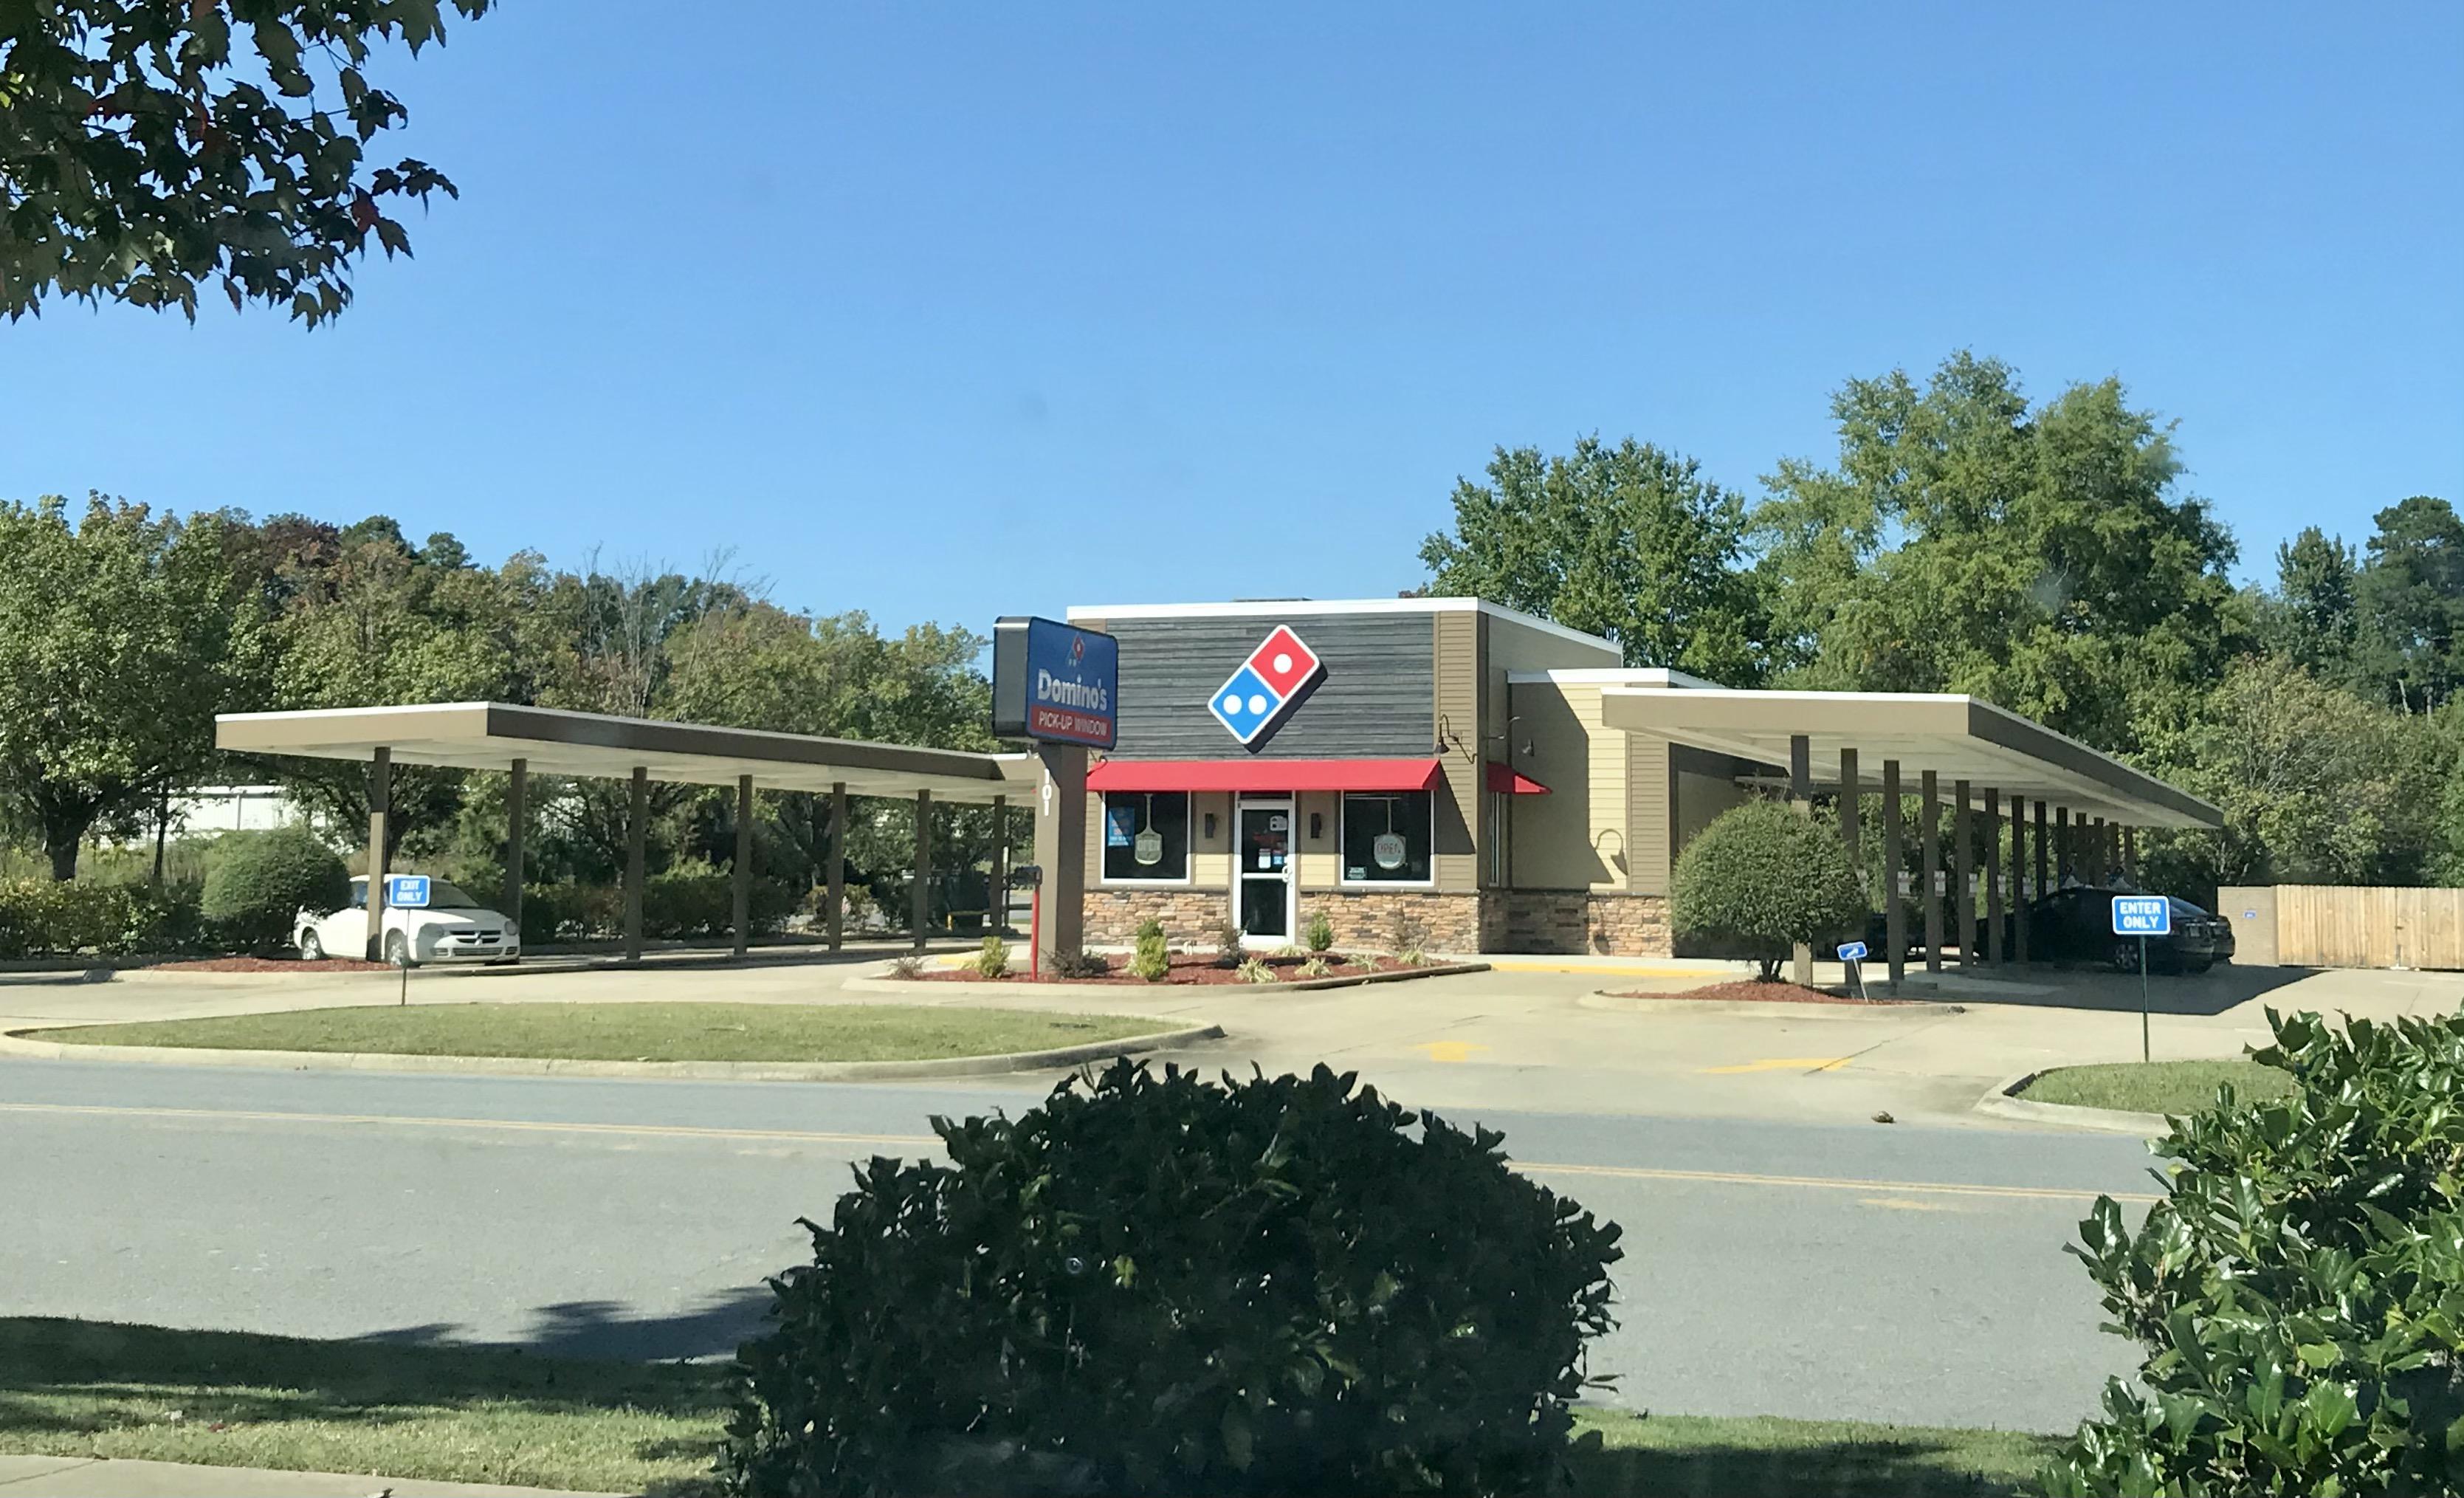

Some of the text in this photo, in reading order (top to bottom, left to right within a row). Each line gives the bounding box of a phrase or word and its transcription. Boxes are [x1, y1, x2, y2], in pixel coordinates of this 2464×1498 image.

[1038, 669, 1107, 711] Domino's
[1039, 711, 1107, 737] PICK-UP WINDOW
[1042, 768, 1052, 817] 101
[399, 879, 421, 891] EXIT
[396, 891, 423, 901] ONLY
[2119, 901, 2161, 915] ENTER
[2122, 915, 2159, 929] ONLY
